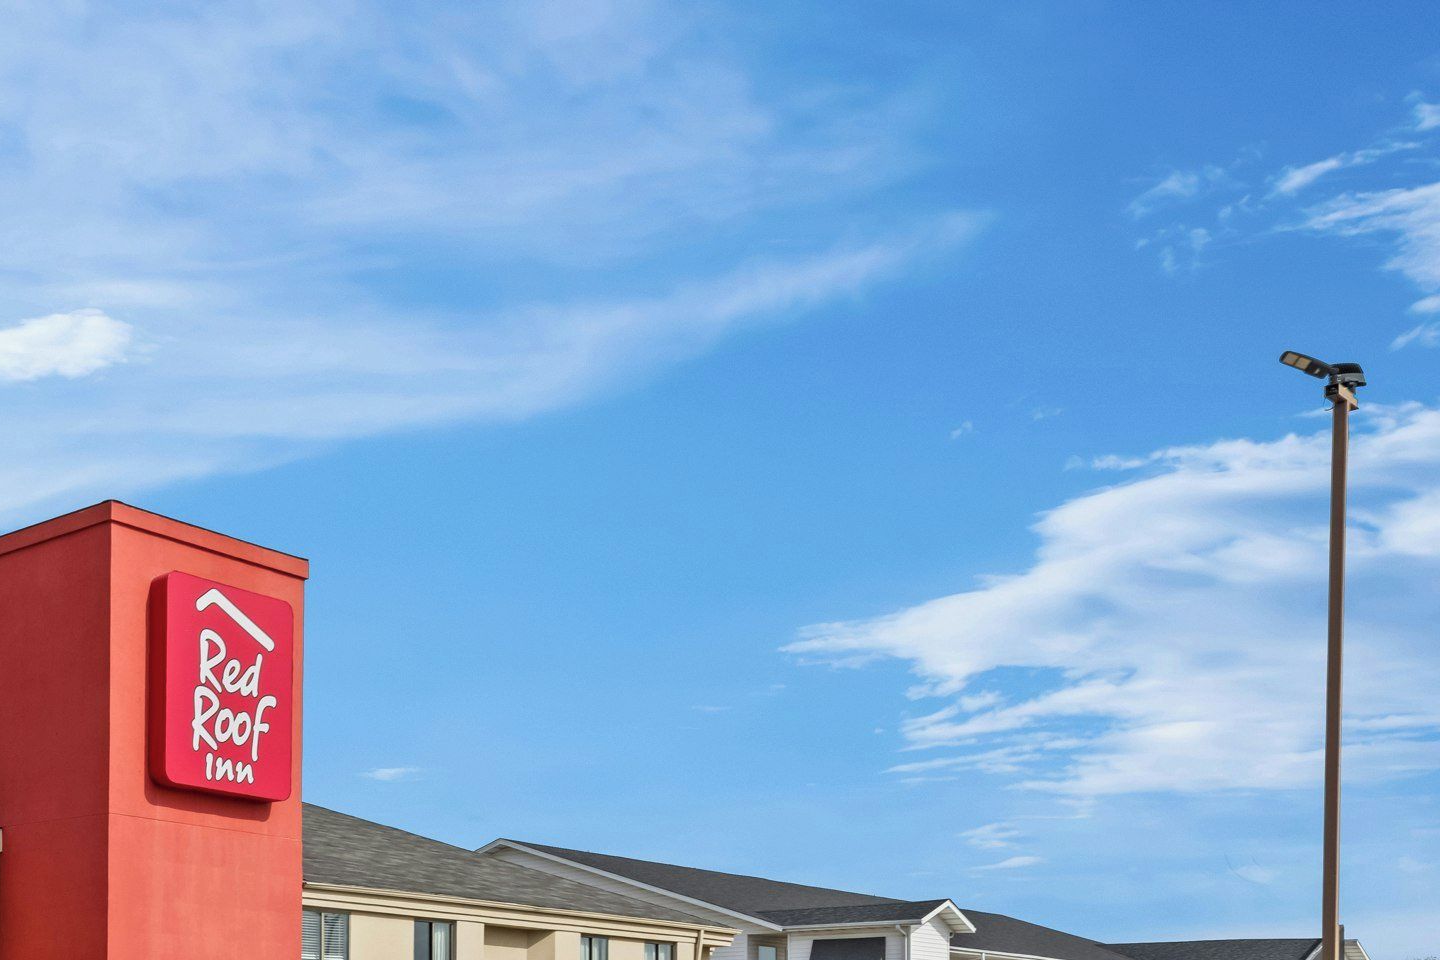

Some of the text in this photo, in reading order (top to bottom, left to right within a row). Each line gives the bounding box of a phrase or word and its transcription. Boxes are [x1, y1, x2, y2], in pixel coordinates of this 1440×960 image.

[199, 628, 262, 697] Red
[192, 685, 277, 761] Roof
[205, 752, 254, 784] Inn
